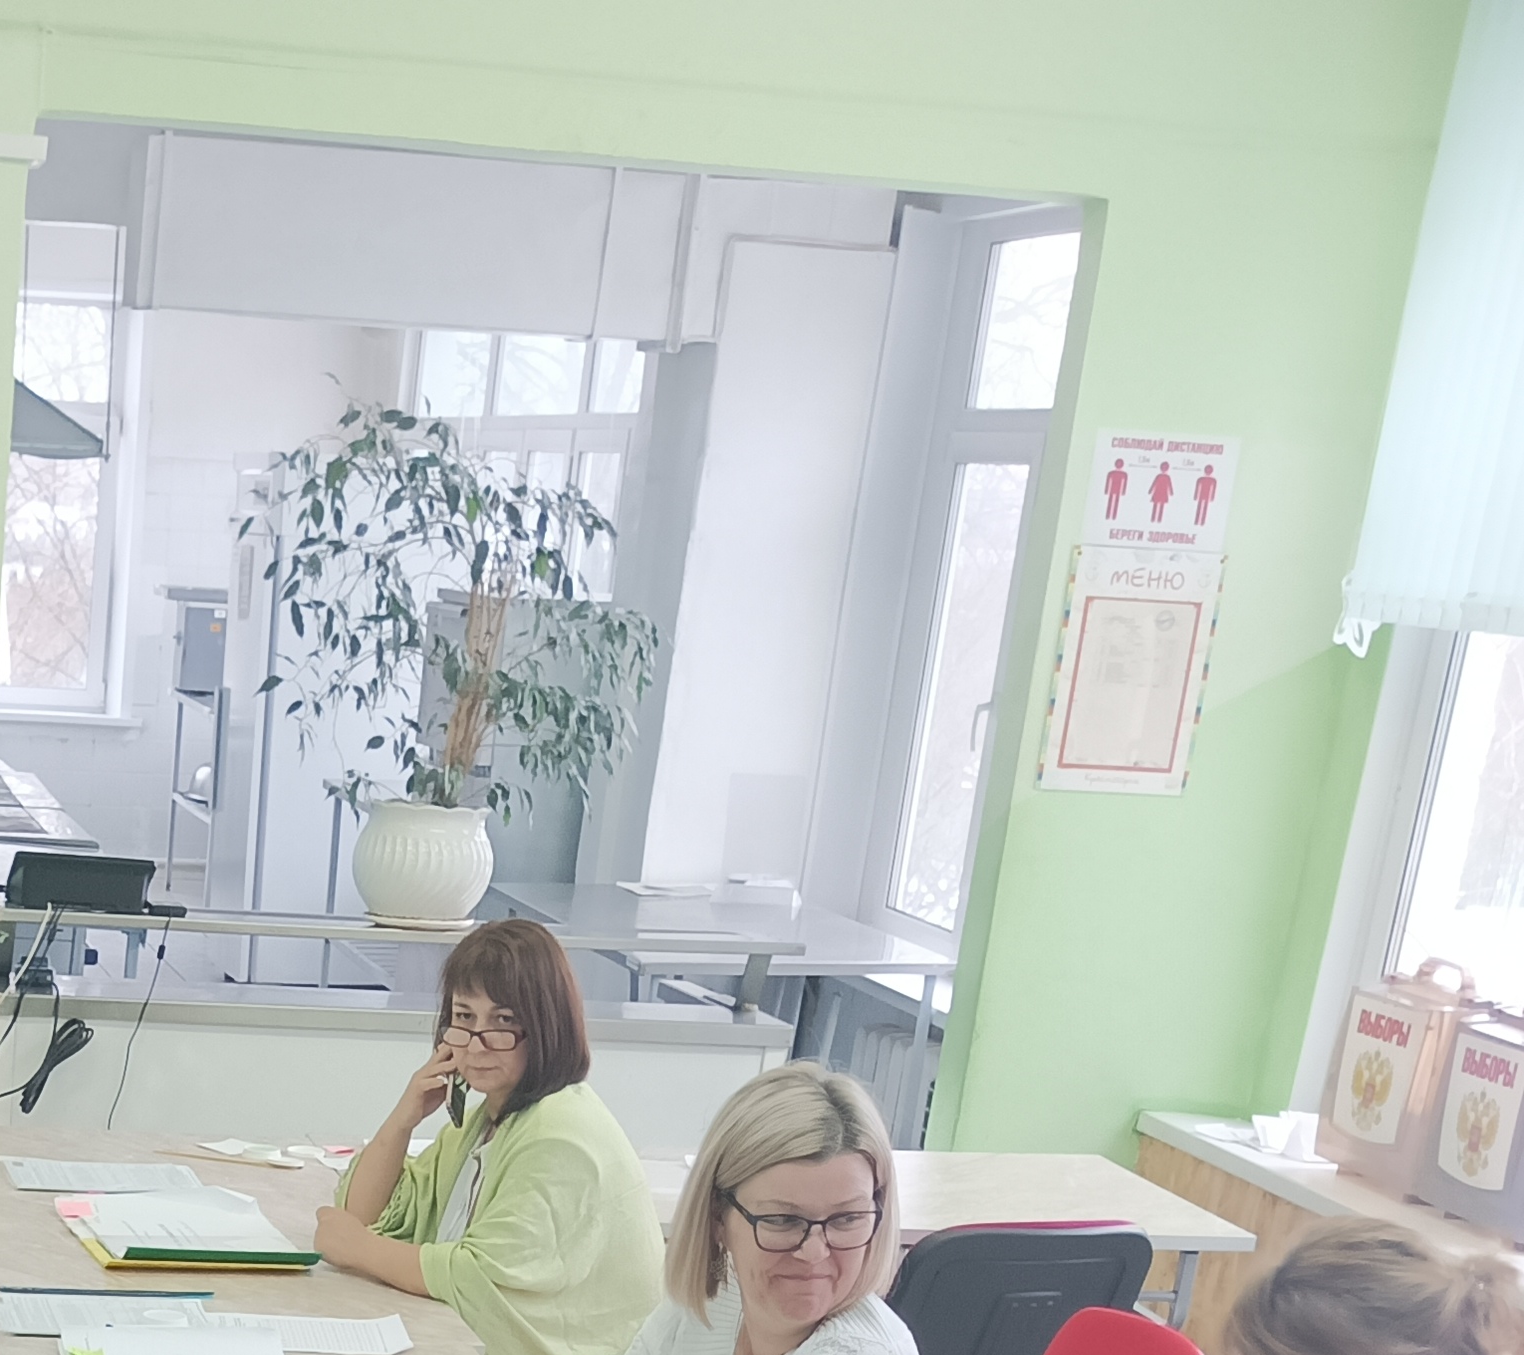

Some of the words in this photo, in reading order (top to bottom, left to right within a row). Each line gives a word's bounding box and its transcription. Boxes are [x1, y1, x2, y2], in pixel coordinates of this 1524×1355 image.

[1111, 436, 1165, 452] СОБЛЮДАЙ
[1166, 441, 1224, 456] ДИСТАНЦИЮ
[1109, 528, 1144, 542] БЕРЕГИ
[1147, 530, 1197, 545] ЗДОРОВЬЕ
[1110, 567, 1186, 591] МЕНЮ
[1357, 1008, 1412, 1048] ВЫБОРЫ
[1461, 1046, 1519, 1089] ВЫБОРЫ
